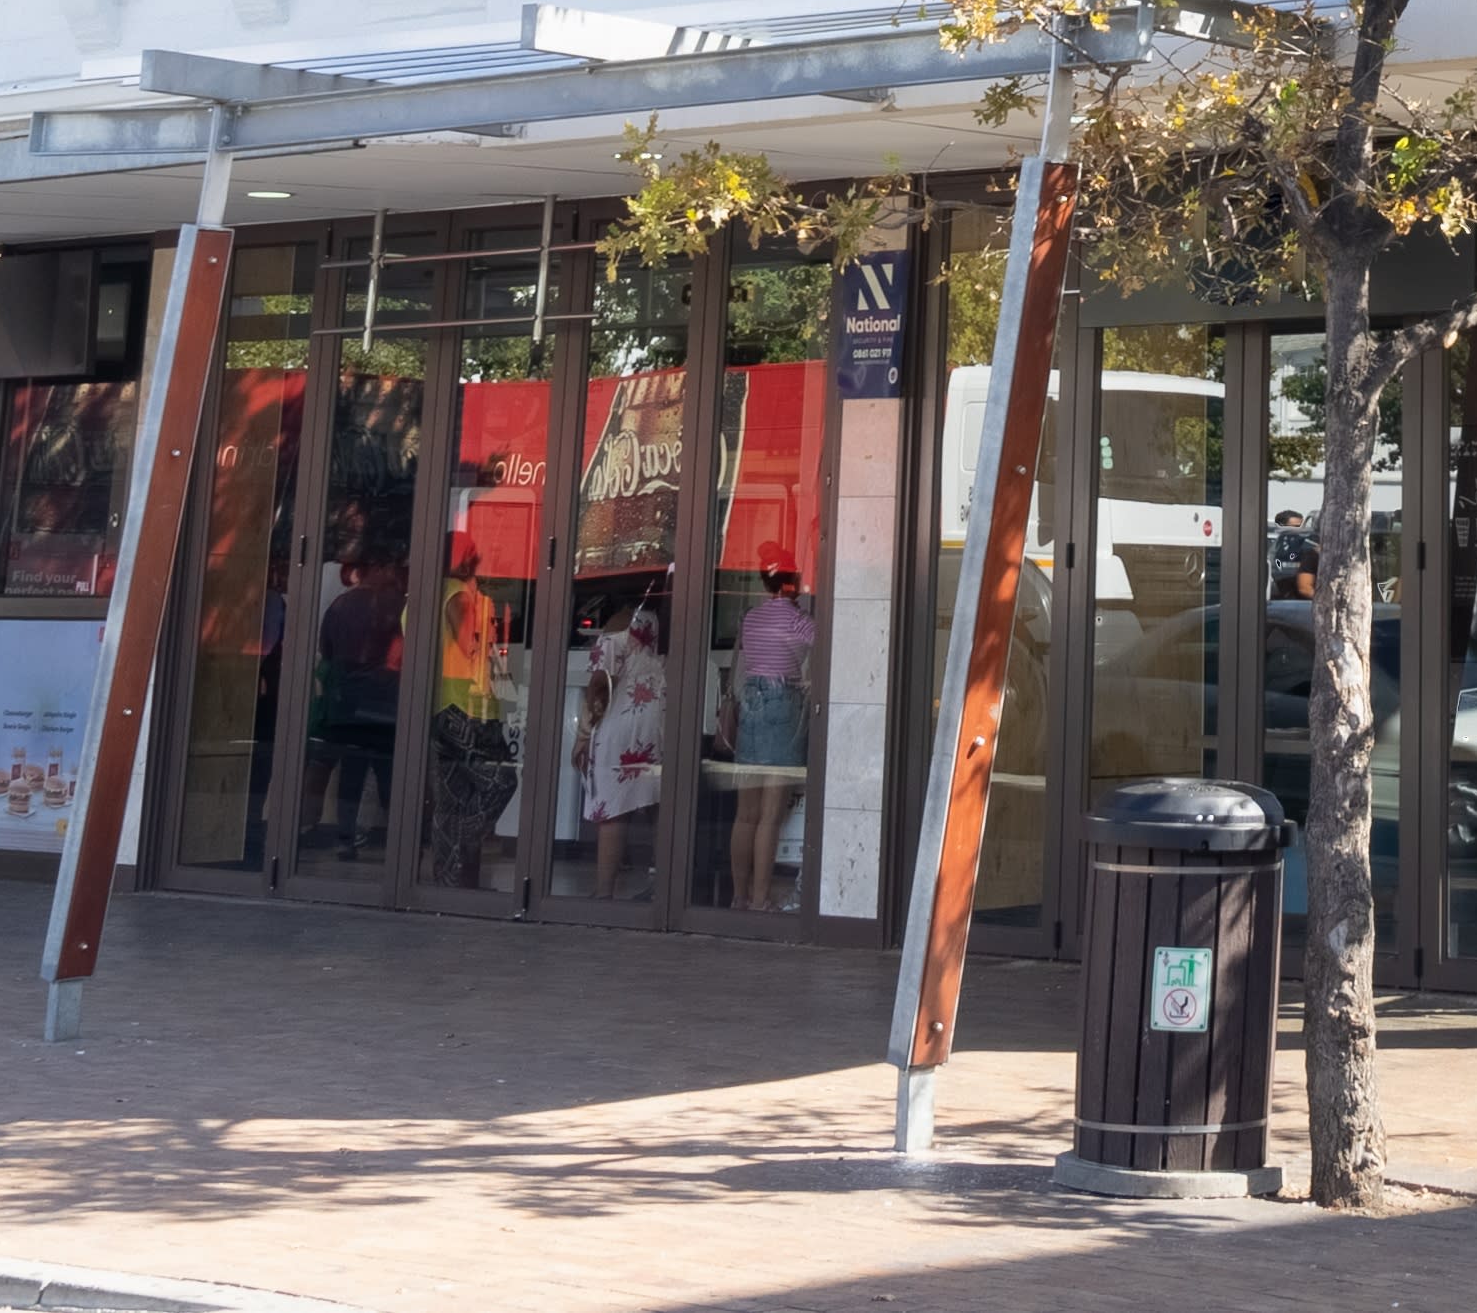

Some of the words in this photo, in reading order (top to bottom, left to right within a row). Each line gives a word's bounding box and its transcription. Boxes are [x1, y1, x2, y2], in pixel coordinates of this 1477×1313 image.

[846, 314, 901, 333] National
[12, 570, 43, 583] Find
[44, 573, 77, 585] your
[76, 581, 90, 592] PULL
